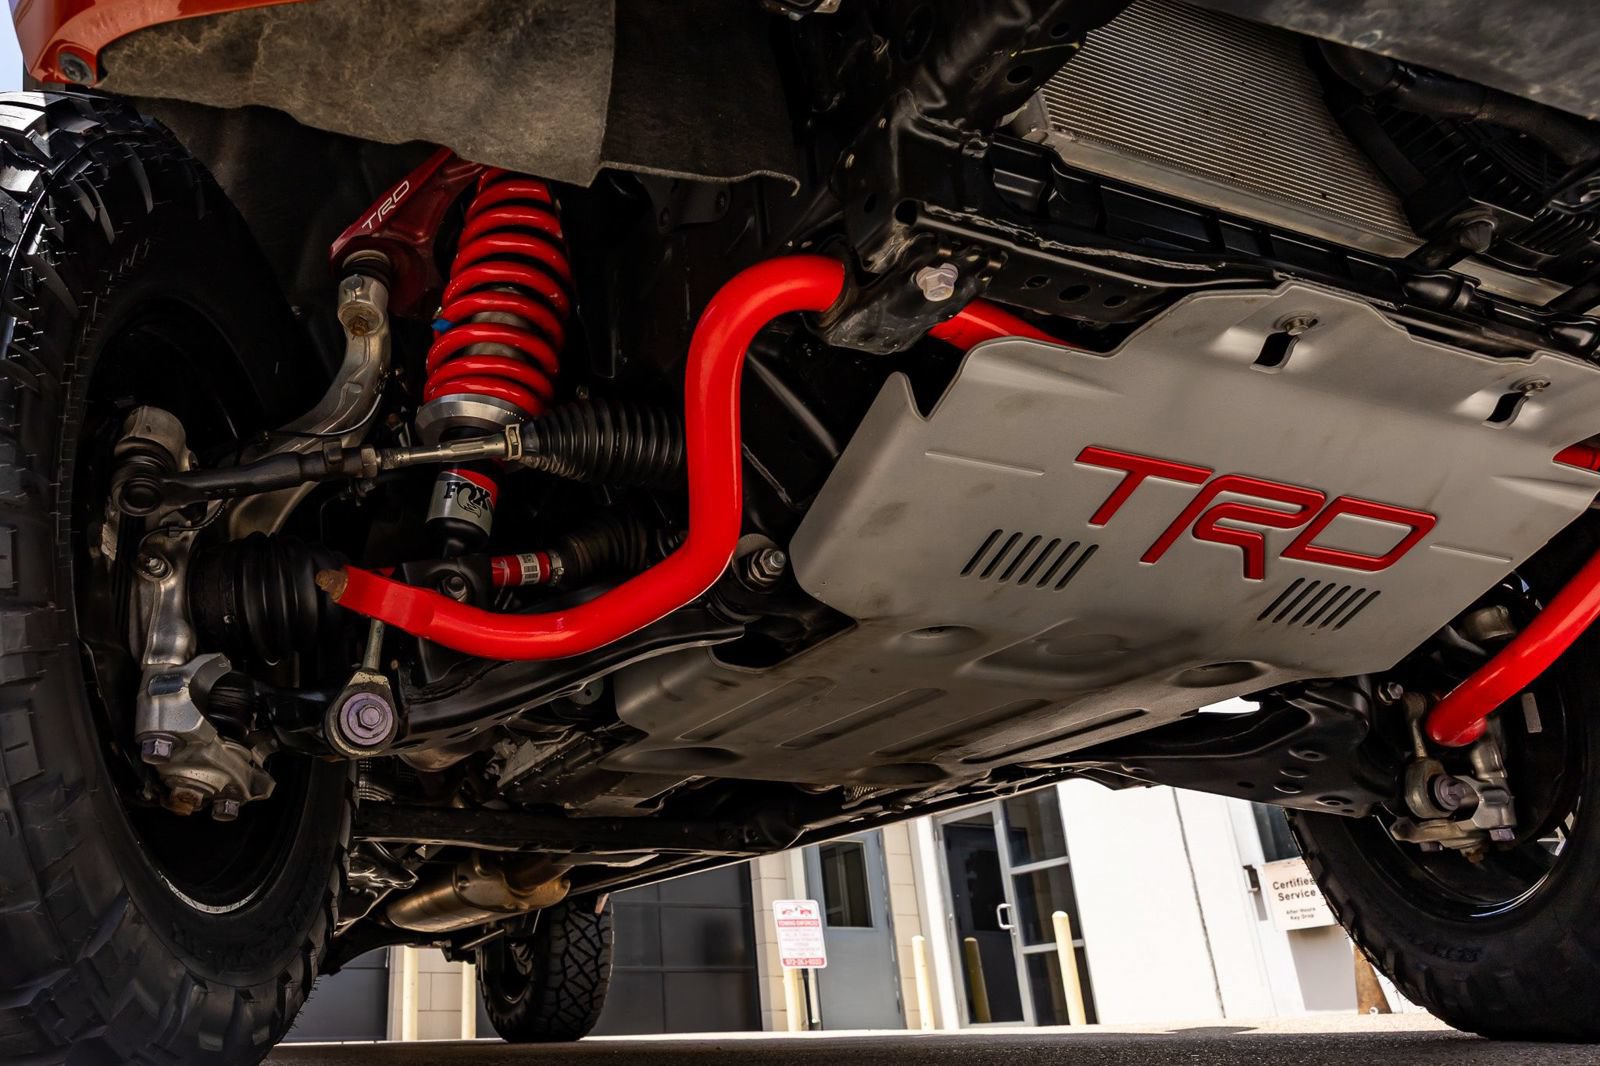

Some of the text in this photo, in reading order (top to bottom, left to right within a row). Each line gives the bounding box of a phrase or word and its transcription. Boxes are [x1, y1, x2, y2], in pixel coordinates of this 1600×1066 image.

[361, 180, 409, 229] TRD
[444, 481, 491, 518] FOX
[1075, 445, 1437, 581] TRD
[1278, 889, 1316, 901] Service
